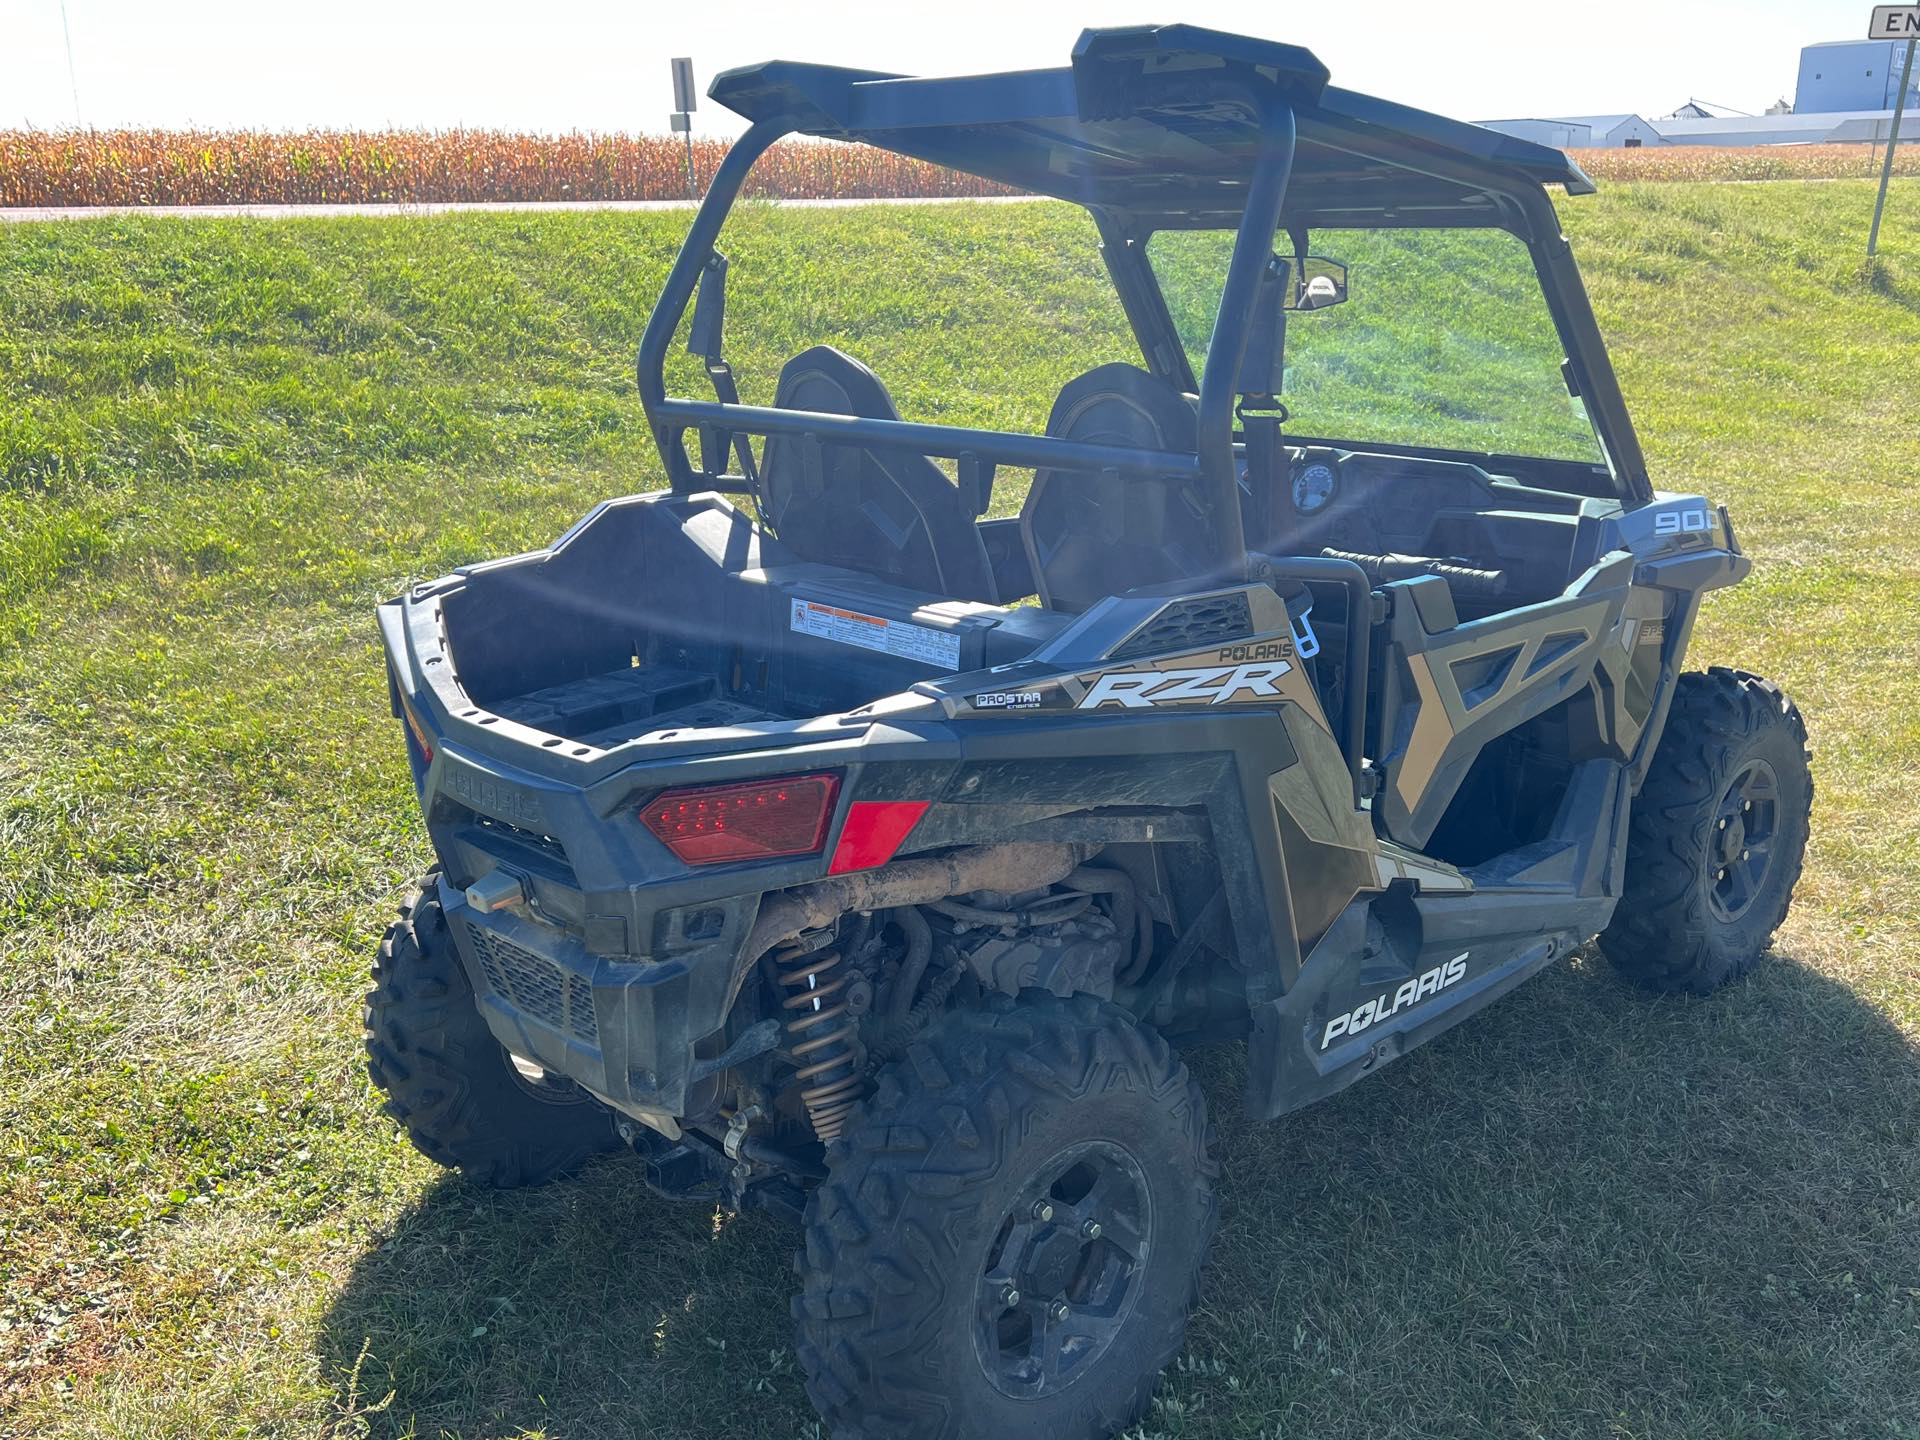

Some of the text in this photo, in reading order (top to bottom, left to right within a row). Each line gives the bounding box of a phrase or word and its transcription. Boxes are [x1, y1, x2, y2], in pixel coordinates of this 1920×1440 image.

[1886, 13, 1920, 32] EN
[1655, 510, 1720, 535] 900
[1219, 643, 1293, 661] POLARIS
[1078, 660, 1292, 708] RZR
[977, 692, 1041, 706] PROSTAR
[1321, 951, 1470, 1050] POLARIS
